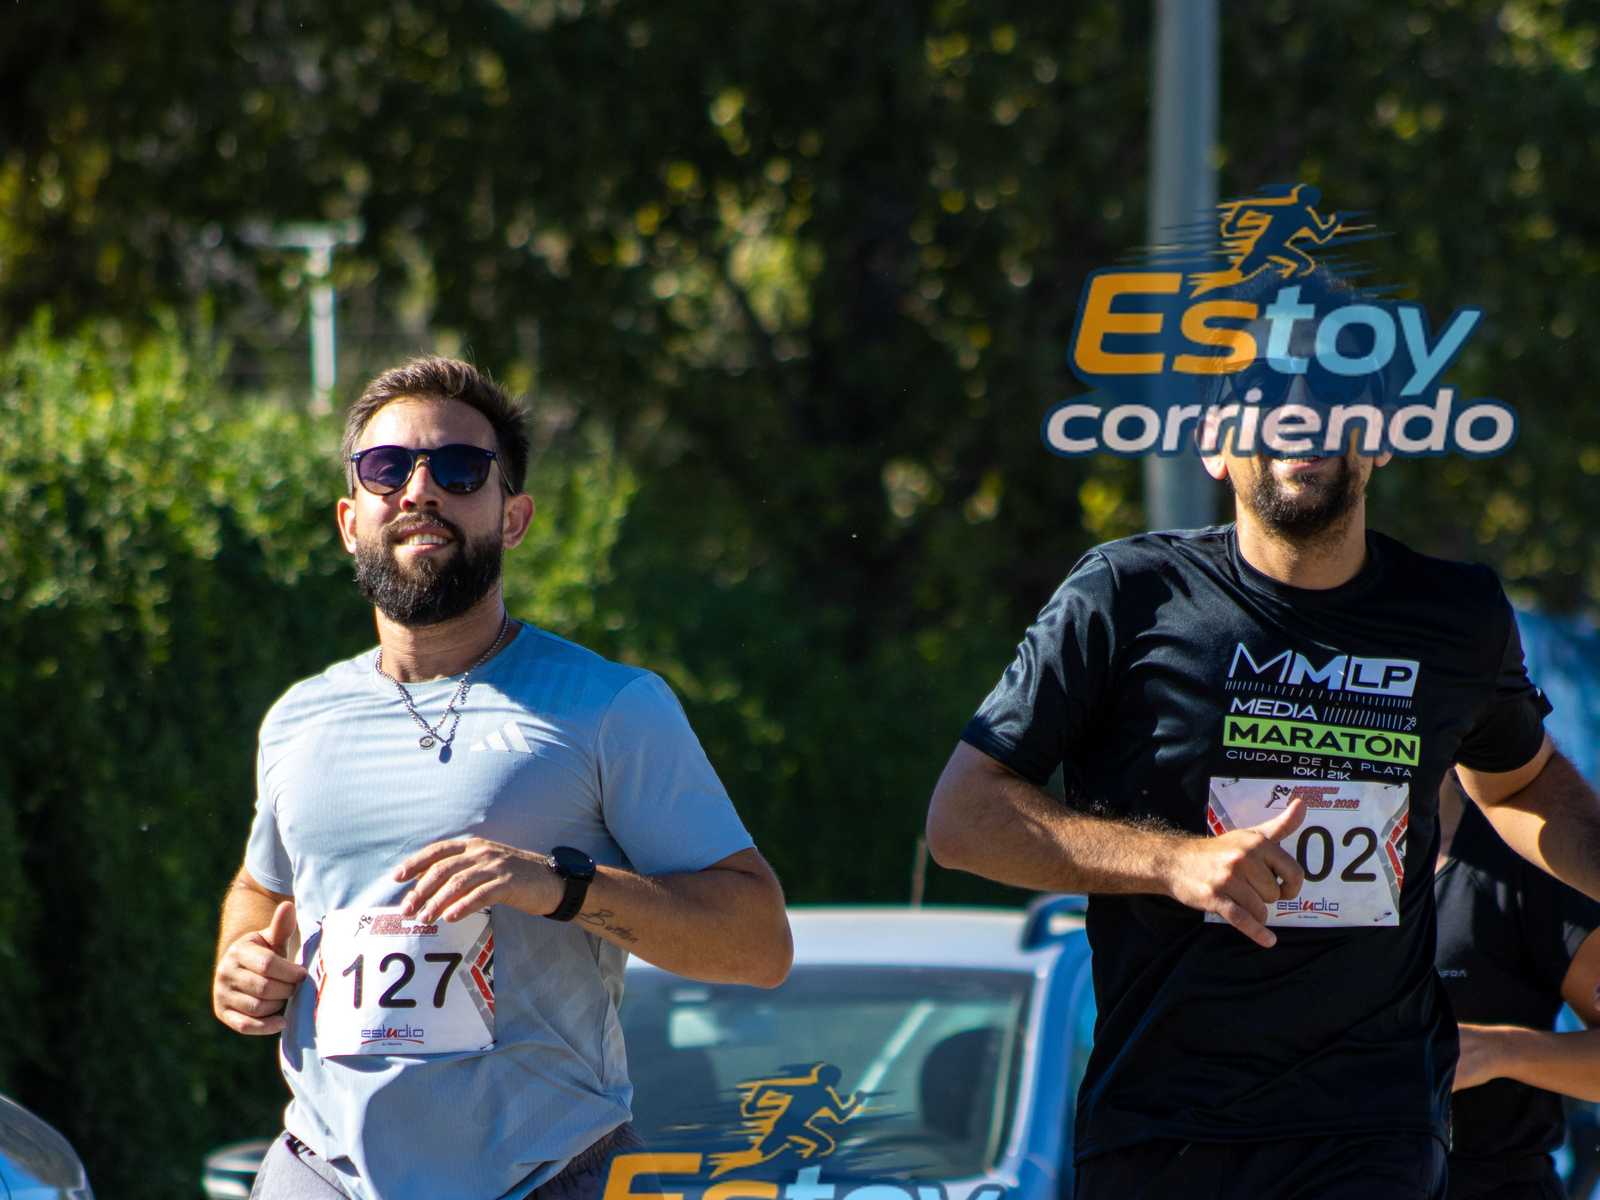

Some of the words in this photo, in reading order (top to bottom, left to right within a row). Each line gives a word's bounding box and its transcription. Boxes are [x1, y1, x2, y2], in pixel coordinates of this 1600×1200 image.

[1228, 642, 1415, 692] MMLP
[1230, 697, 1318, 721] MEDIA
[1229, 721, 1417, 761] MARATÓN
[1226, 750, 1292, 764] CIUDAD
[1299, 755, 1322, 767] DE
[1329, 759, 1353, 770] LA
[1361, 762, 1412, 778] PLATA
[1292, 766, 1318, 777] 10K
[1327, 770, 1351, 781] 21K
[1296, 825, 1378, 884] 02
[342, 952, 464, 1010] 127
